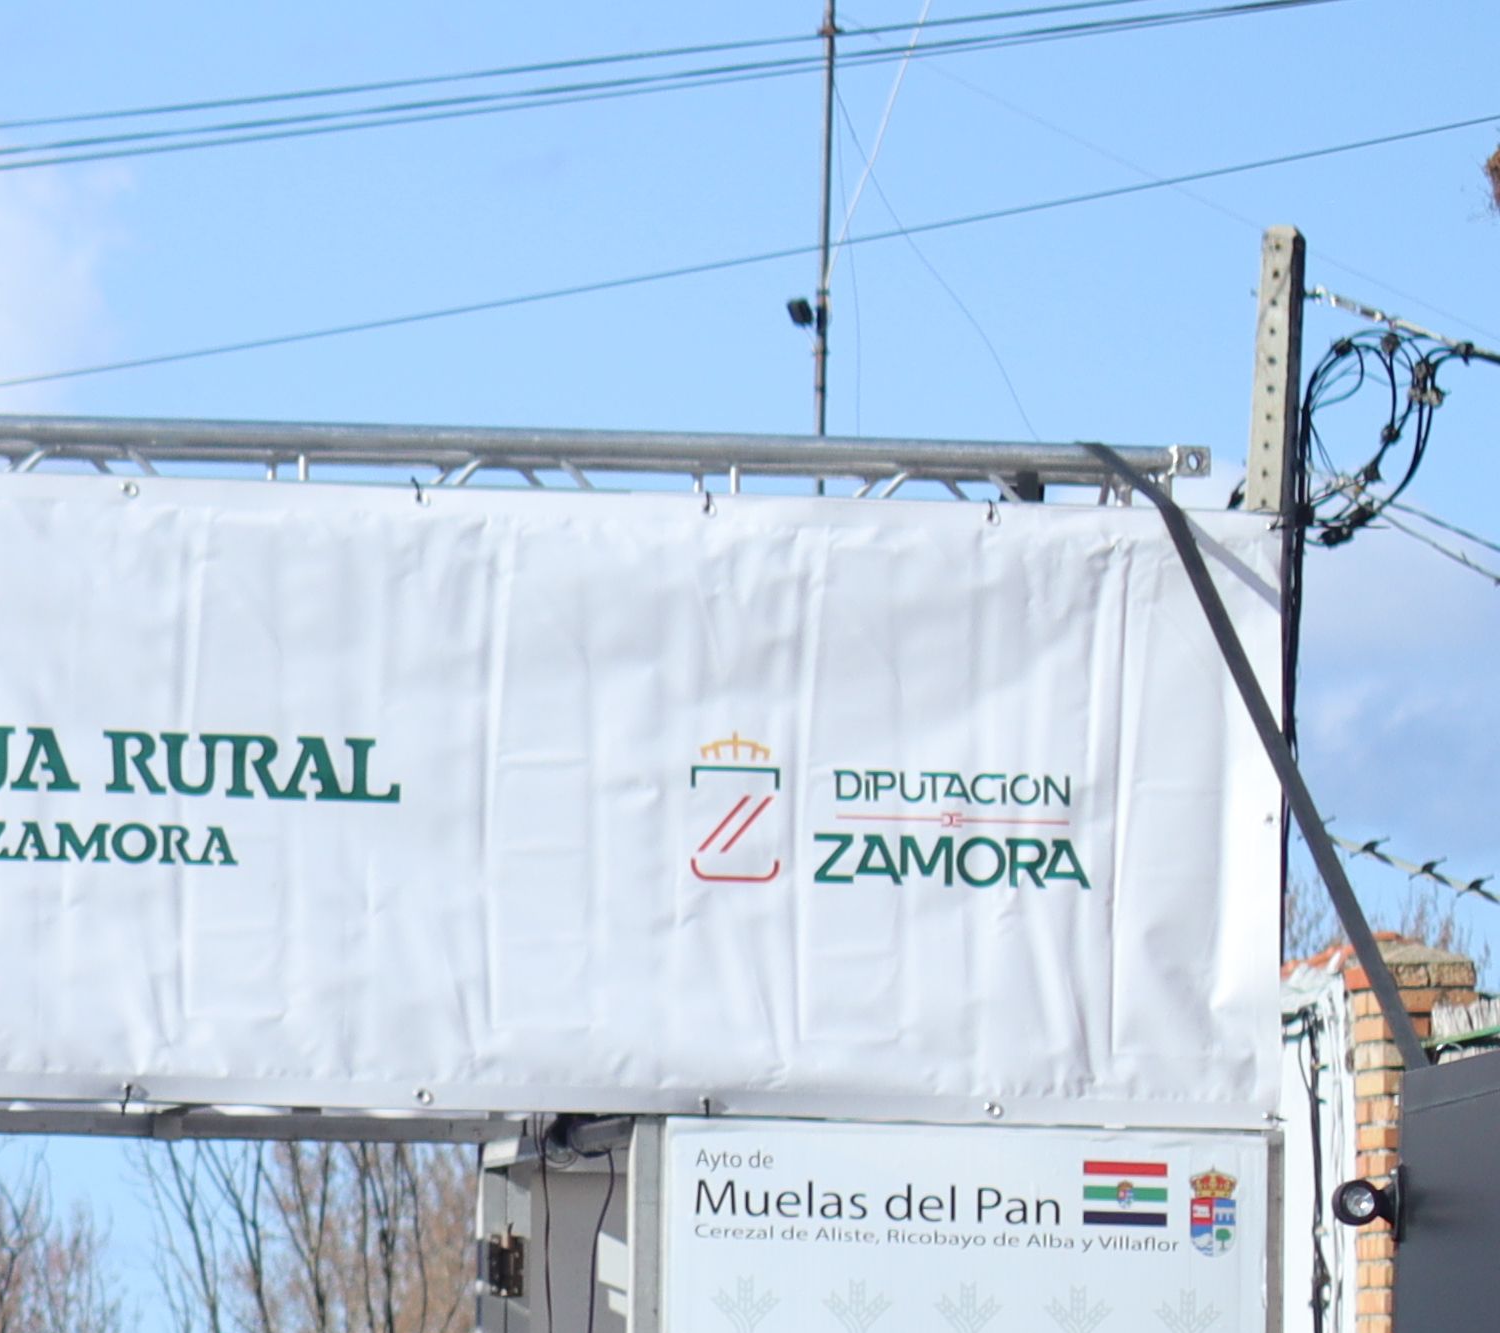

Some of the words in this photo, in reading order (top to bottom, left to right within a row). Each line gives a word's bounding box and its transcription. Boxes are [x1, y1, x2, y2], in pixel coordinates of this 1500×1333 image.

[104, 731, 400, 803] RURAL
[814, 834, 1090, 889] ZAMORA
[696, 1149, 742, 1172] Ayto
[749, 1150, 773, 1168] de
[696, 1180, 867, 1219] Muelas
[886, 1184, 955, 1221] del
[978, 1188, 1060, 1224] Pan
[695, 1224, 773, 1240] Cerezal
[781, 1226, 807, 1240] de
[816, 1227, 879, 1244] Aliste,
[887, 1229, 986, 1248] Ricobayo
[993, 1232, 1019, 1246] de
[1027, 1234, 1074, 1248] Alba
[1082, 1239, 1093, 1252] y
[1099, 1236, 1178, 1251] Villaflor
